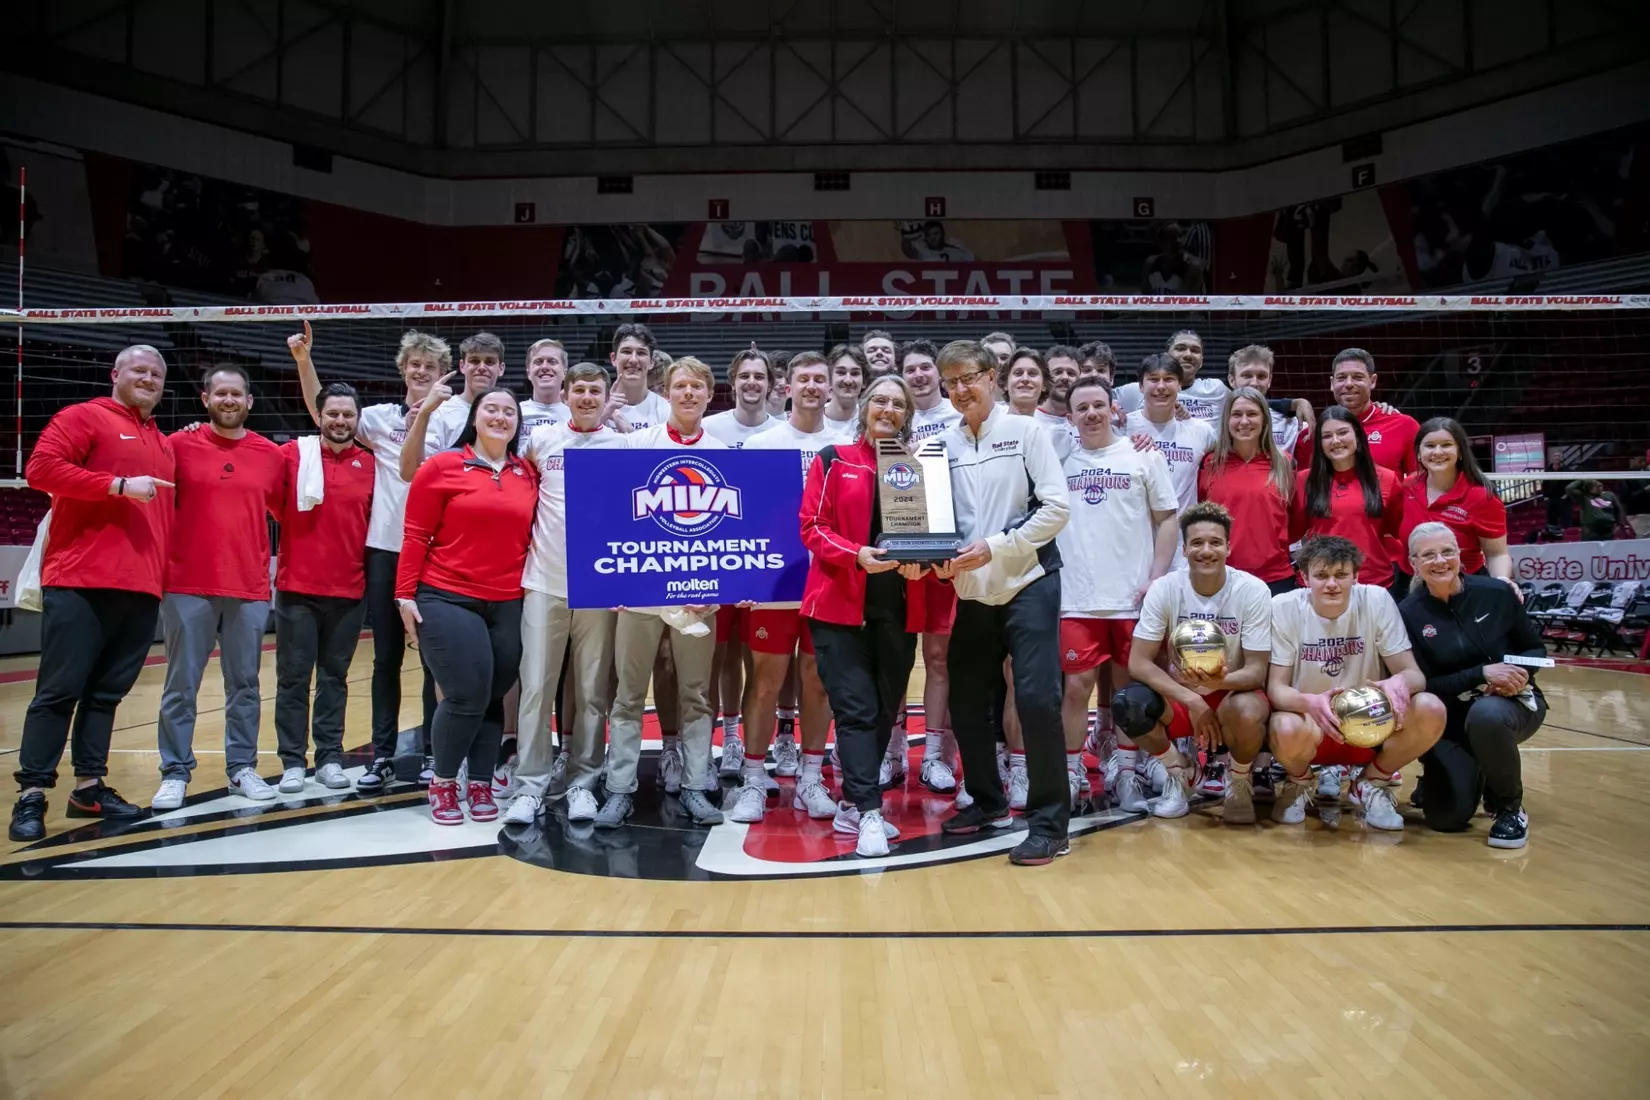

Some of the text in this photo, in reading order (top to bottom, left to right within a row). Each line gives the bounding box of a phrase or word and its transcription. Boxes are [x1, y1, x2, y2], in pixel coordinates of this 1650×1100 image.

[1358, 169, 1368, 185] F
[521, 206, 529, 219] J
[929, 201, 942, 216] H
[1138, 202, 1150, 216] G
[690, 269, 1076, 321] BALL STATE
[842, 297, 999, 306] BALL STATE VOLLEYBALL
[1055, 297, 1210, 305] BALL STATE VOLLEYBALL
[1264, 297, 1417, 305] BALL STATE VOLLEYBALL
[1471, 297, 1502, 305] BALL
[1505, 297, 1543, 305] STATE
[1546, 297, 1623, 305] VOLLEYBALL
[257, 306, 294, 314] STATE
[297, 305, 371, 314] VOLLEYBALL
[424, 302, 575, 312] BALL STATE VOLLEYBALL
[630, 298, 786, 308] BALL STATE VOLLEYBALL
[27, 310, 58, 318] BALL
[60, 310, 97, 318] STATE
[100, 309, 173, 317] VOLLEYBALL
[1467, 357, 1481, 374] 3
[917, 423, 946, 433] 2024
[653, 459, 721, 484] MIDWESTERN INTERCOLLEGIATE
[883, 472, 920, 484] MIVA
[1080, 468, 1112, 477] 2024
[635, 485, 740, 517] MIVA
[660, 515, 719, 533] VOLLEYBALL ASSOCIATION
[607, 539, 770, 555] TOURNAMENT
[594, 553, 785, 574] CHAMPIONS
[1518, 557, 1584, 580] State
[666, 578, 719, 592] molten
[665, 592, 677, 600] For
